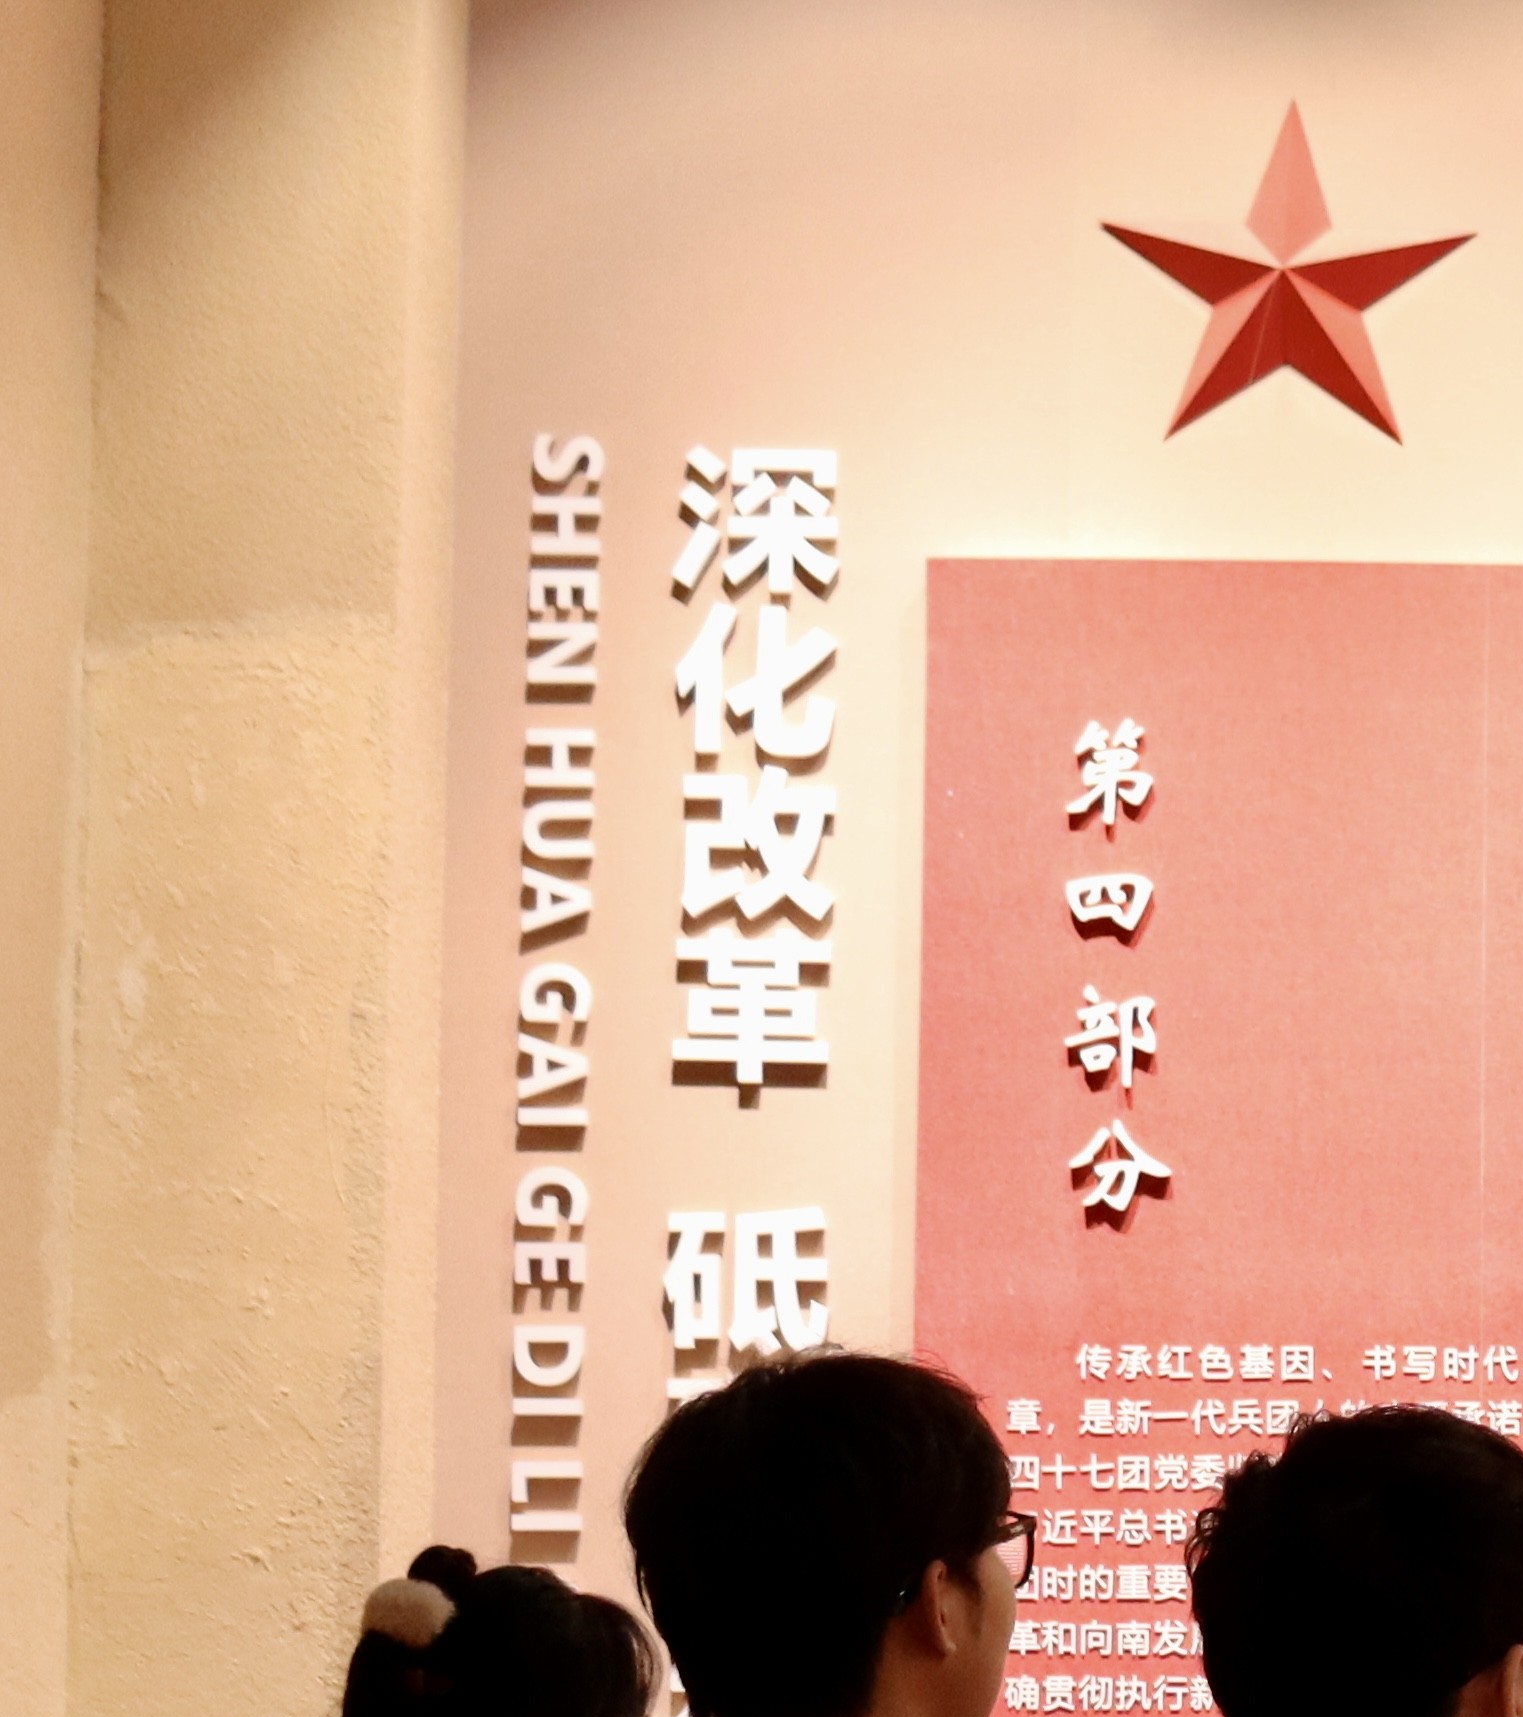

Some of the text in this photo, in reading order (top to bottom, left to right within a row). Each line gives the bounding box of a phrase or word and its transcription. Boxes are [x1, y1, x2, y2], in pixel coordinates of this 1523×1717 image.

[526, 433, 606, 684] SHEN
[520, 728, 597, 945] HUA
[670, 445, 840, 1086] 深化改革
[517, 962, 595, 1128] GAI
[1064, 717, 1172, 1213] 第四部分
[513, 1165, 590, 1286] GE
[511, 1324, 586, 1417] DI
[1008, 1452, 1246, 1493] 四十七团党委
[1018, 1508, 1203, 1547] 近平总书
